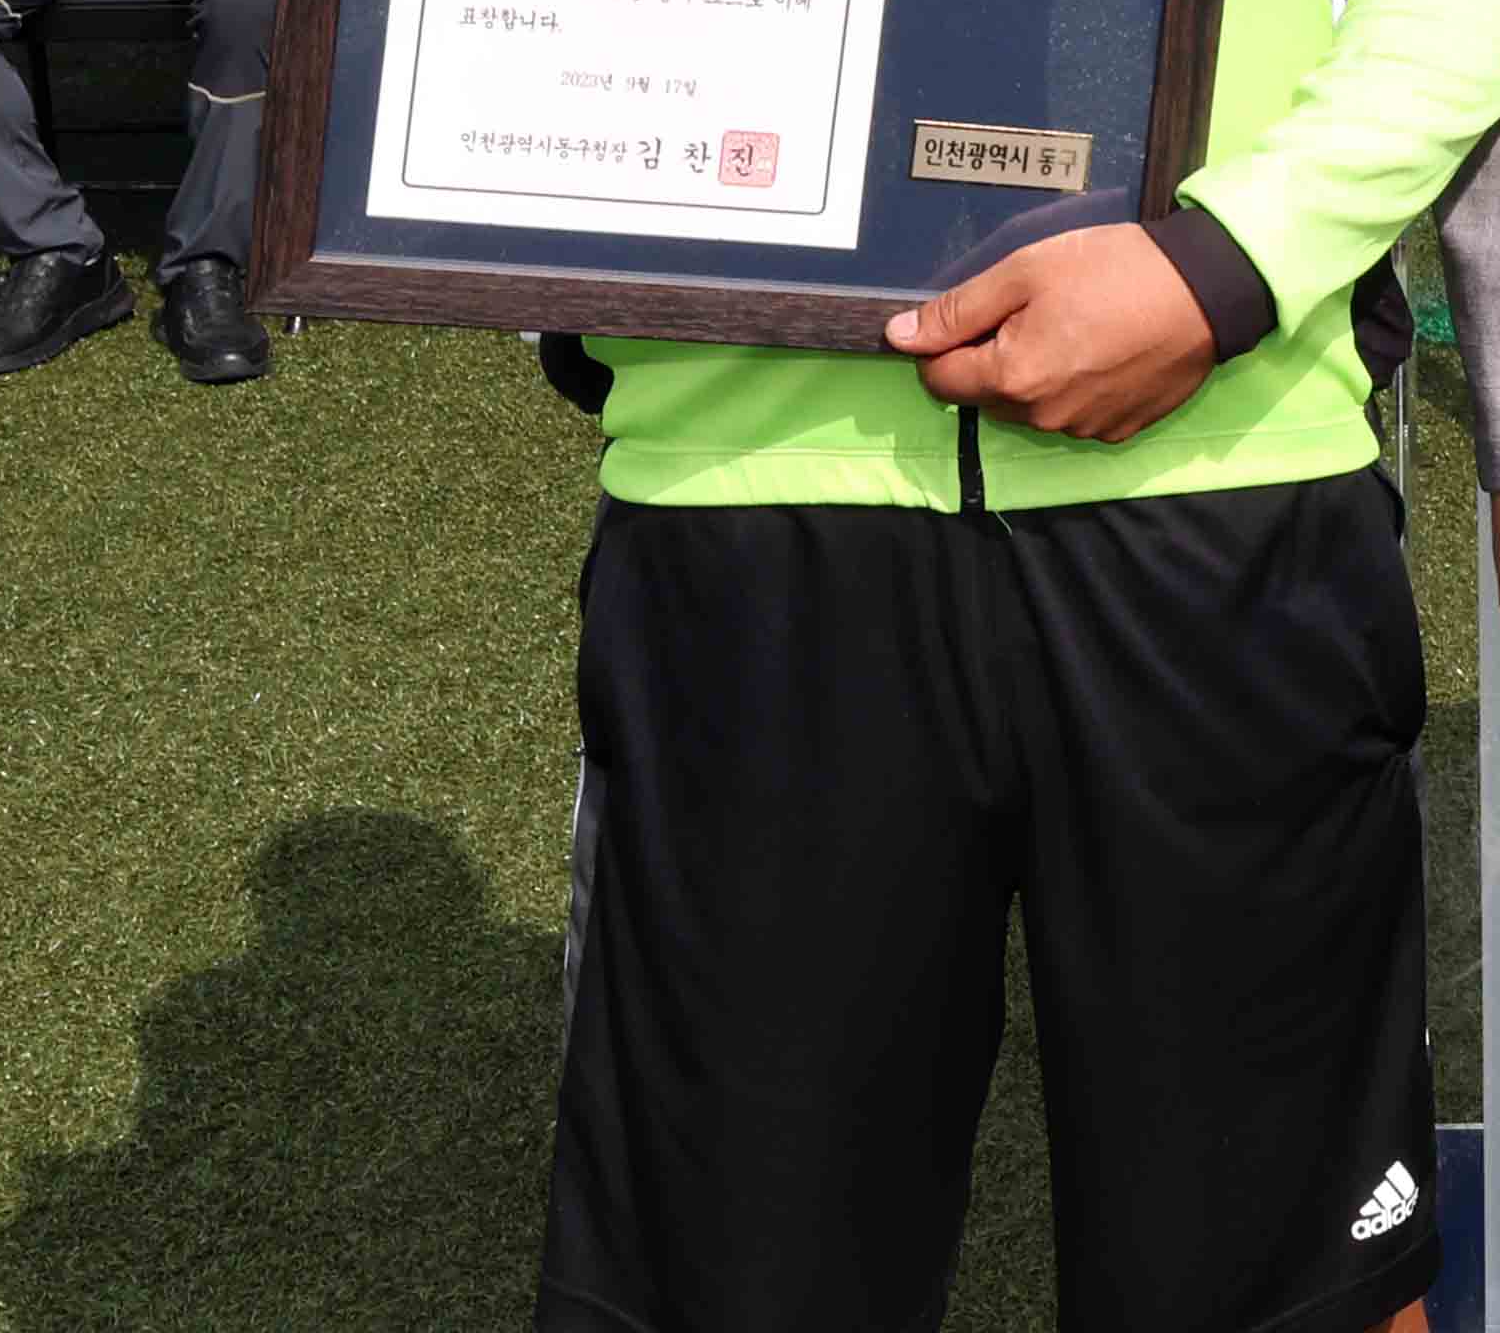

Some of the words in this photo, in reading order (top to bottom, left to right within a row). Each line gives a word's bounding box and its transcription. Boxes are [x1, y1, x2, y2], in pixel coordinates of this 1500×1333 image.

[461, 130, 627, 164] 인천광역시동구청장
[924, 138, 1030, 174] 인천광역시
[1037, 147, 1077, 177] 동구
